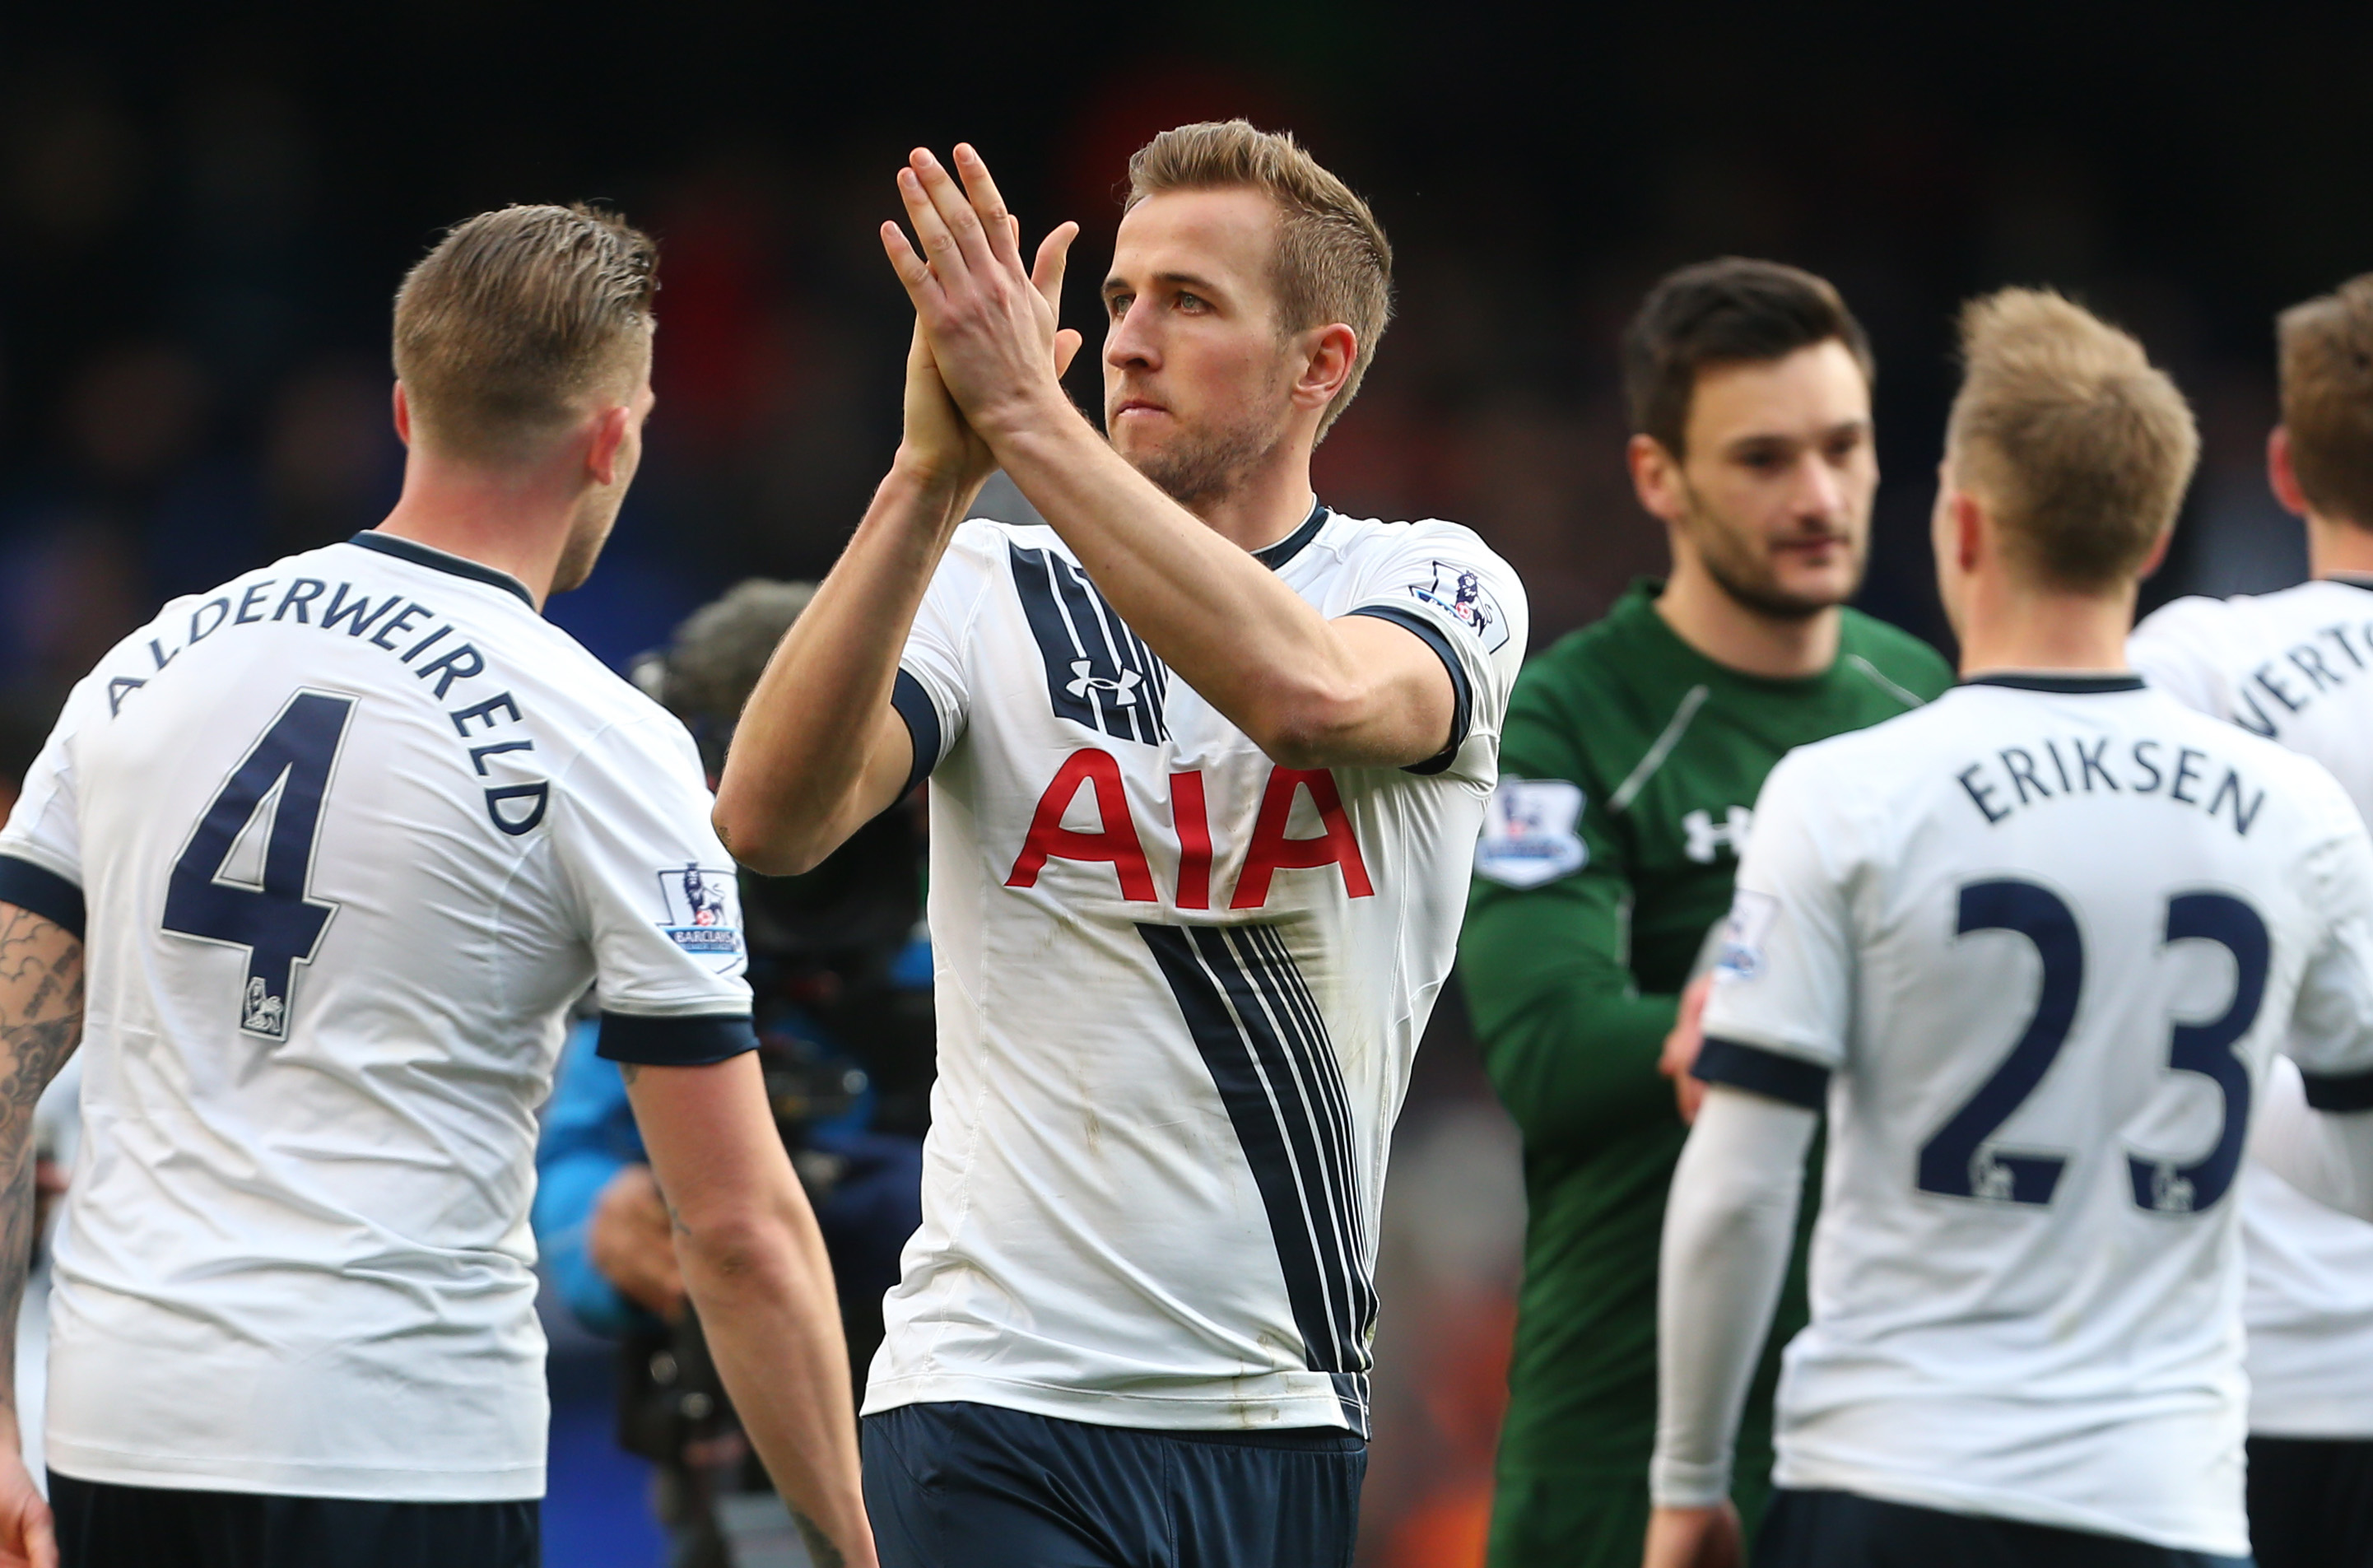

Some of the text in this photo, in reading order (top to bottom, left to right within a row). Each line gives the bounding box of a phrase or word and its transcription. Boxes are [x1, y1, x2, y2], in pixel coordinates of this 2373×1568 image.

[106, 578, 549, 835] ALDERWEIRELD
[1956, 738, 2266, 835] ERIKSEN
[161, 686, 359, 1041] 4
[1004, 747, 1375, 910] AIA
[674, 931, 733, 943] BARCLAYS
[1915, 877, 2273, 1212] 23
